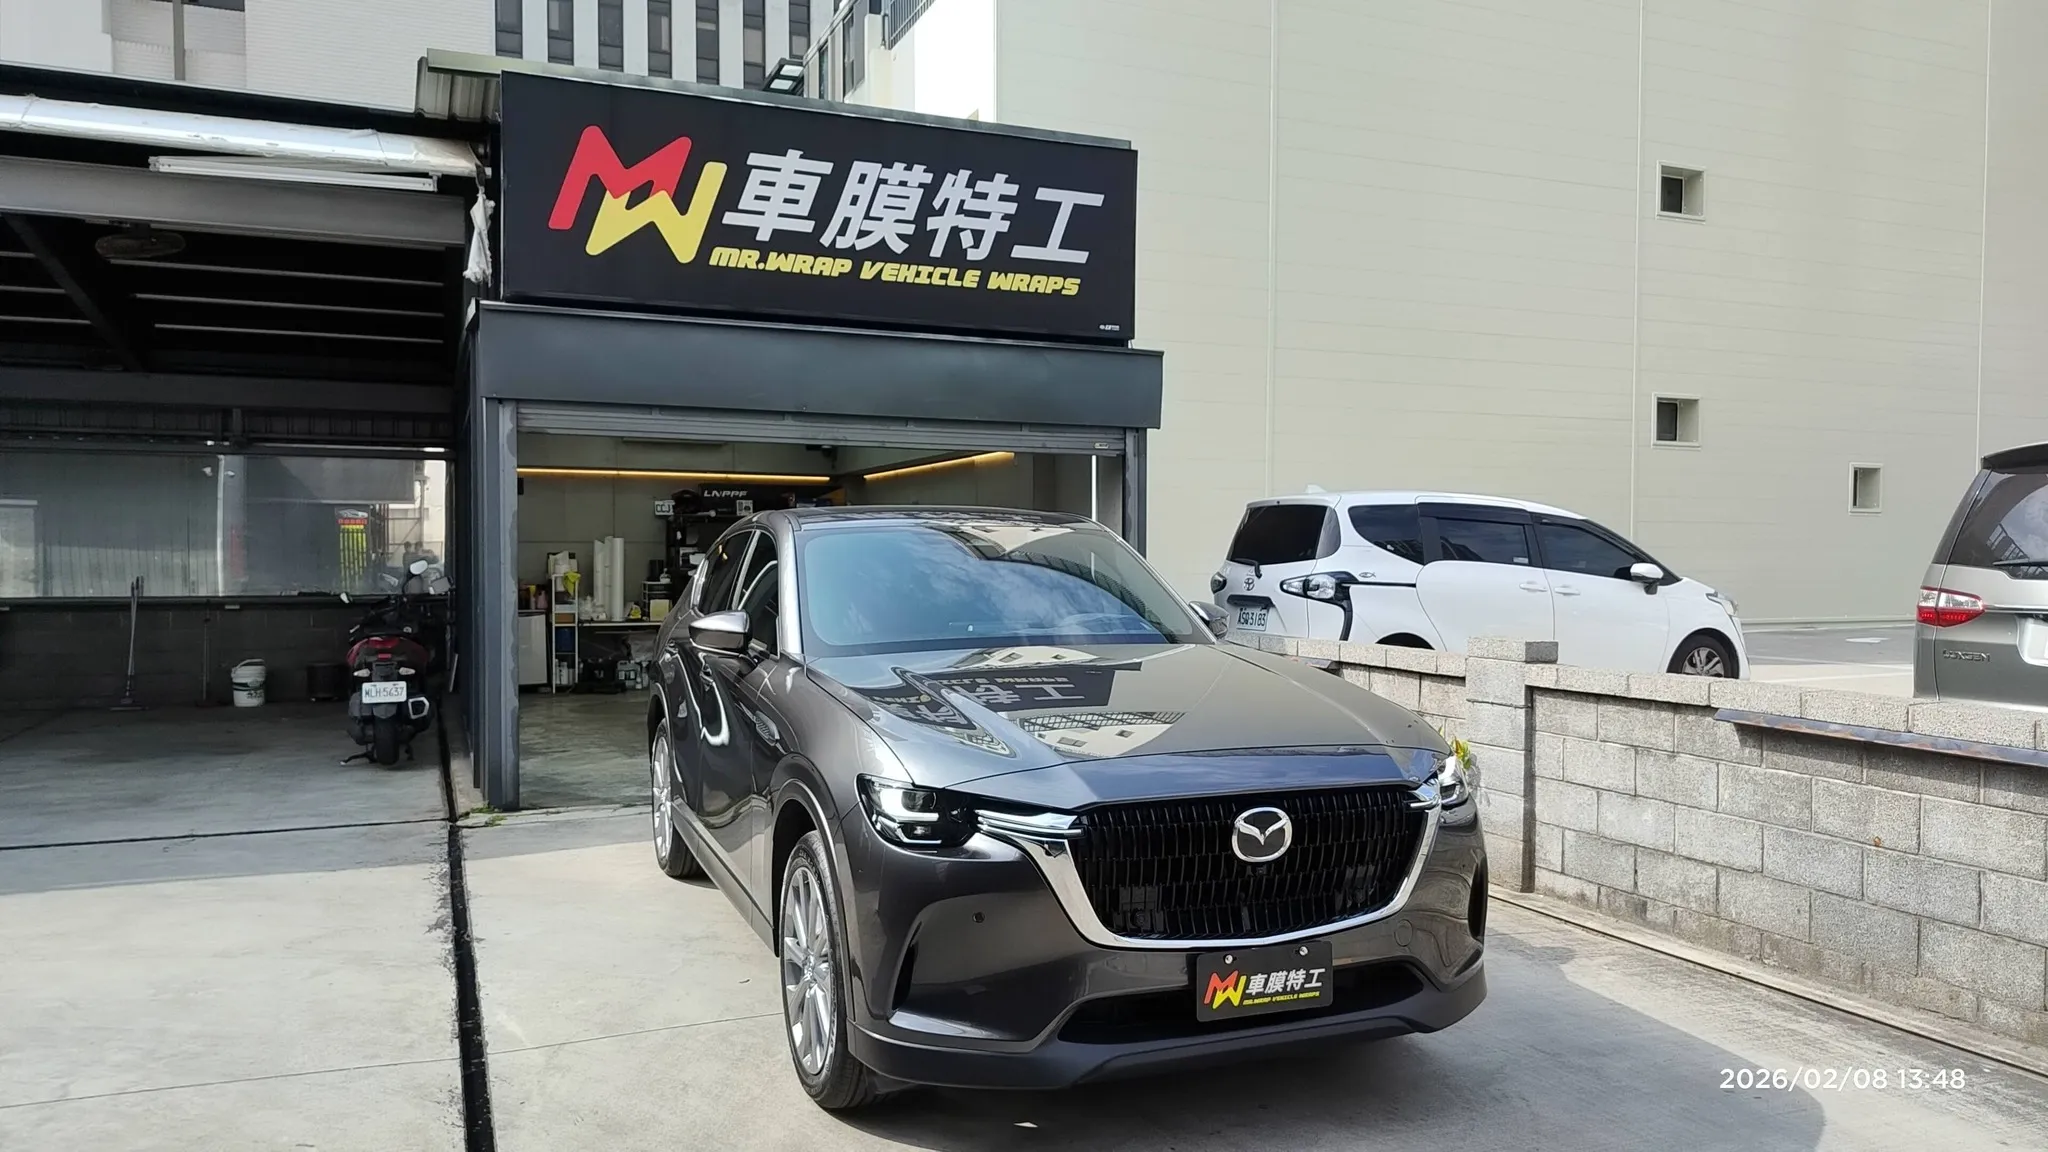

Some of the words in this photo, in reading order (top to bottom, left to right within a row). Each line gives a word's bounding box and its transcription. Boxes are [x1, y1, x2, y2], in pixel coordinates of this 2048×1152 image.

[721, 148, 1105, 264] 車膜特工
[709, 246, 853, 277] MR.WRAP
[859, 260, 982, 288] VEHICLE
[986, 271, 1082, 296] WRAPS
[1245, 968, 1326, 996] 車膜特工
